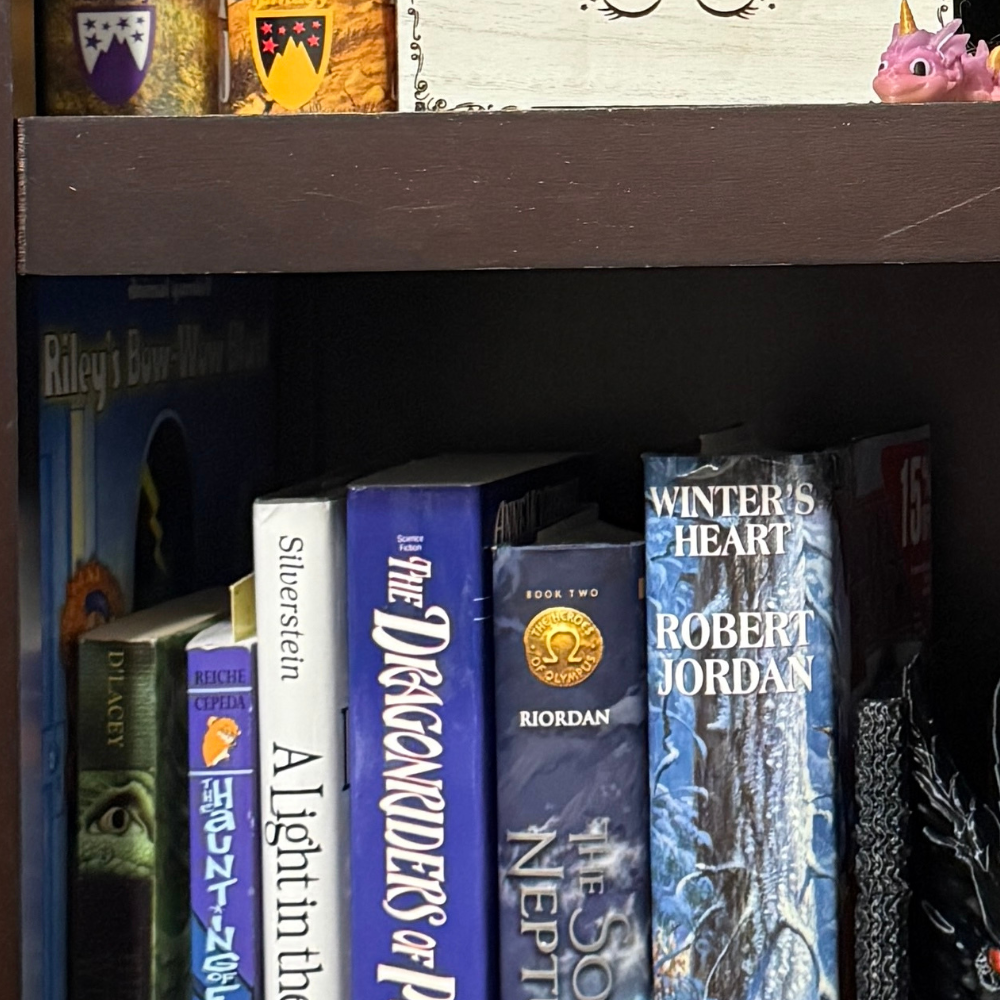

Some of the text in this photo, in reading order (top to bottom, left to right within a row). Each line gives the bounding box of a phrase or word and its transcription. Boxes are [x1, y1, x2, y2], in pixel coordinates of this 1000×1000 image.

[44, 330, 121, 412] Riley's
[649, 482, 815, 519] WINTER'S
[397, 534, 424, 544] Science
[399, 543, 422, 552] Fiction
[674, 522, 792, 557] HEART
[388, 556, 432, 609] THE
[526, 588, 599, 599] BOOK TWO
[278, 535, 304, 681] Silverstein
[530, 611, 595, 638] THE HEROES
[656, 610, 815, 650] ROBERT
[194, 669, 246, 685] REICHE
[531, 655, 596, 684] OF OLYMPUS
[658, 655, 815, 696] JORDAN
[107, 651, 125, 748] D'LACEY
[194, 695, 246, 711] CEPEDA
[519, 708, 611, 728] RIORDAN
[273, 741, 324, 777] A
[371, 605, 451, 926] DRAGONRIDERS
[264, 783, 324, 891] Light
[568, 816, 611, 895] THE
[276, 897, 318, 941] in
[506, 828, 565, 1000] NEPT
[391, 929, 437, 969] OF
